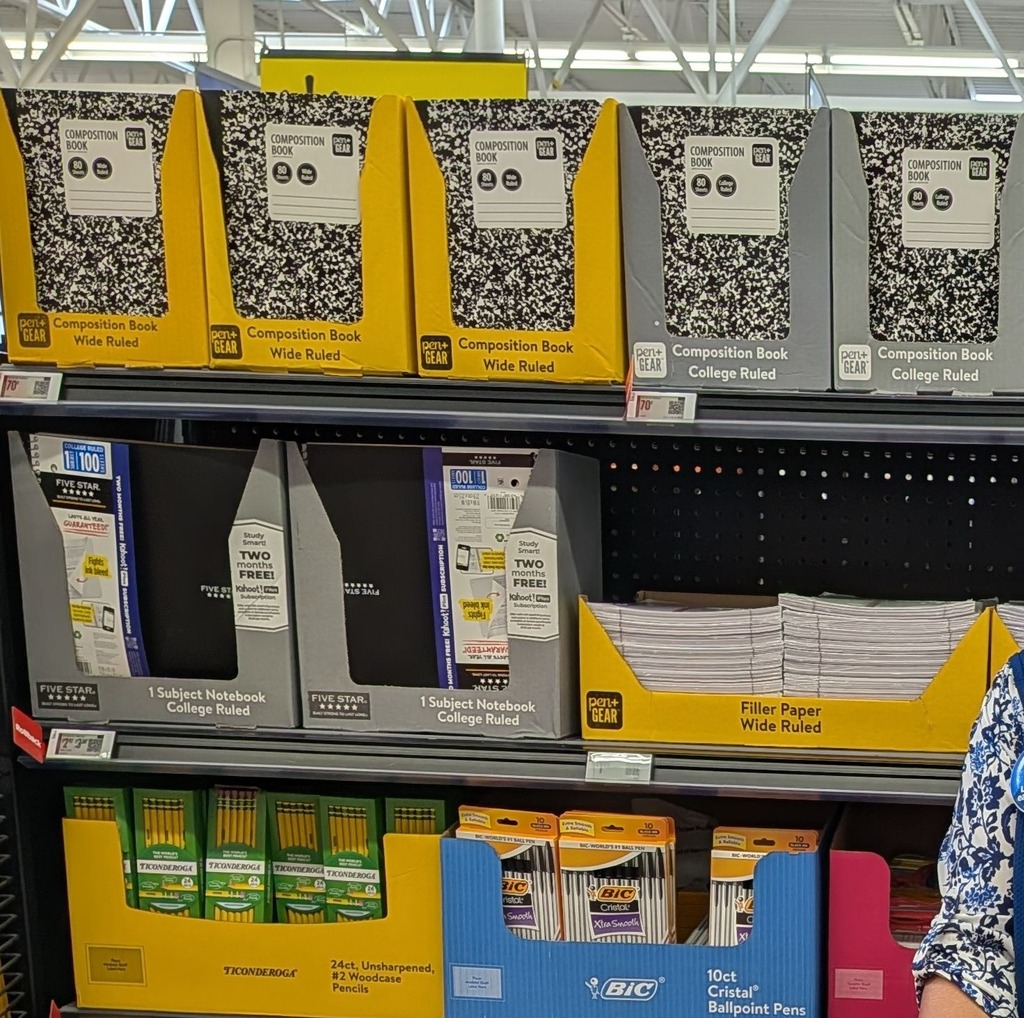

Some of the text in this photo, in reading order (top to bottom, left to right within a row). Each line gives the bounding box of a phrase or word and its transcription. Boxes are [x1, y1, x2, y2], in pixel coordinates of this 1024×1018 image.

[64, 129, 118, 141] COMPOSITION
[66, 140, 88, 151] BOOK
[475, 141, 529, 152] COMPOSITION
[476, 151, 497, 163] BOOK
[907, 159, 962, 171] COMPOSITION
[908, 170, 930, 182] BOOK
[53, 318, 158, 333] Composition Book
[74, 335, 139, 348] Wide Ruled
[458, 338, 574, 354] Composition Book
[672, 344, 788, 360] Composition Book
[483, 360, 555, 373] Wide Ruled
[688, 366, 776, 381] College Ruled
[79, 452, 100, 473] 100
[243, 532, 264, 540] Study
[239, 551, 271, 560] TWO
[236, 561, 273, 569] months
[239, 570, 275, 580] FREE!
[149, 686, 266, 704] 1 Subject Notebook
[167, 702, 250, 717] College Ruled
[740, 702, 822, 719] Filler Paper
[740, 718, 822, 734] Wide Ruled
[140, 862, 193, 872] TICONDEROGA
[223, 966, 298, 979] TICONDEROGA
[330, 960, 435, 974] 24ct, Unsharpened,
[331, 971, 401, 983] #2 Woodcase
[707, 969, 737, 983] 10ct
[332, 983, 369, 994] Pencils
[708, 1001, 806, 1017] Ballpoint Pens
